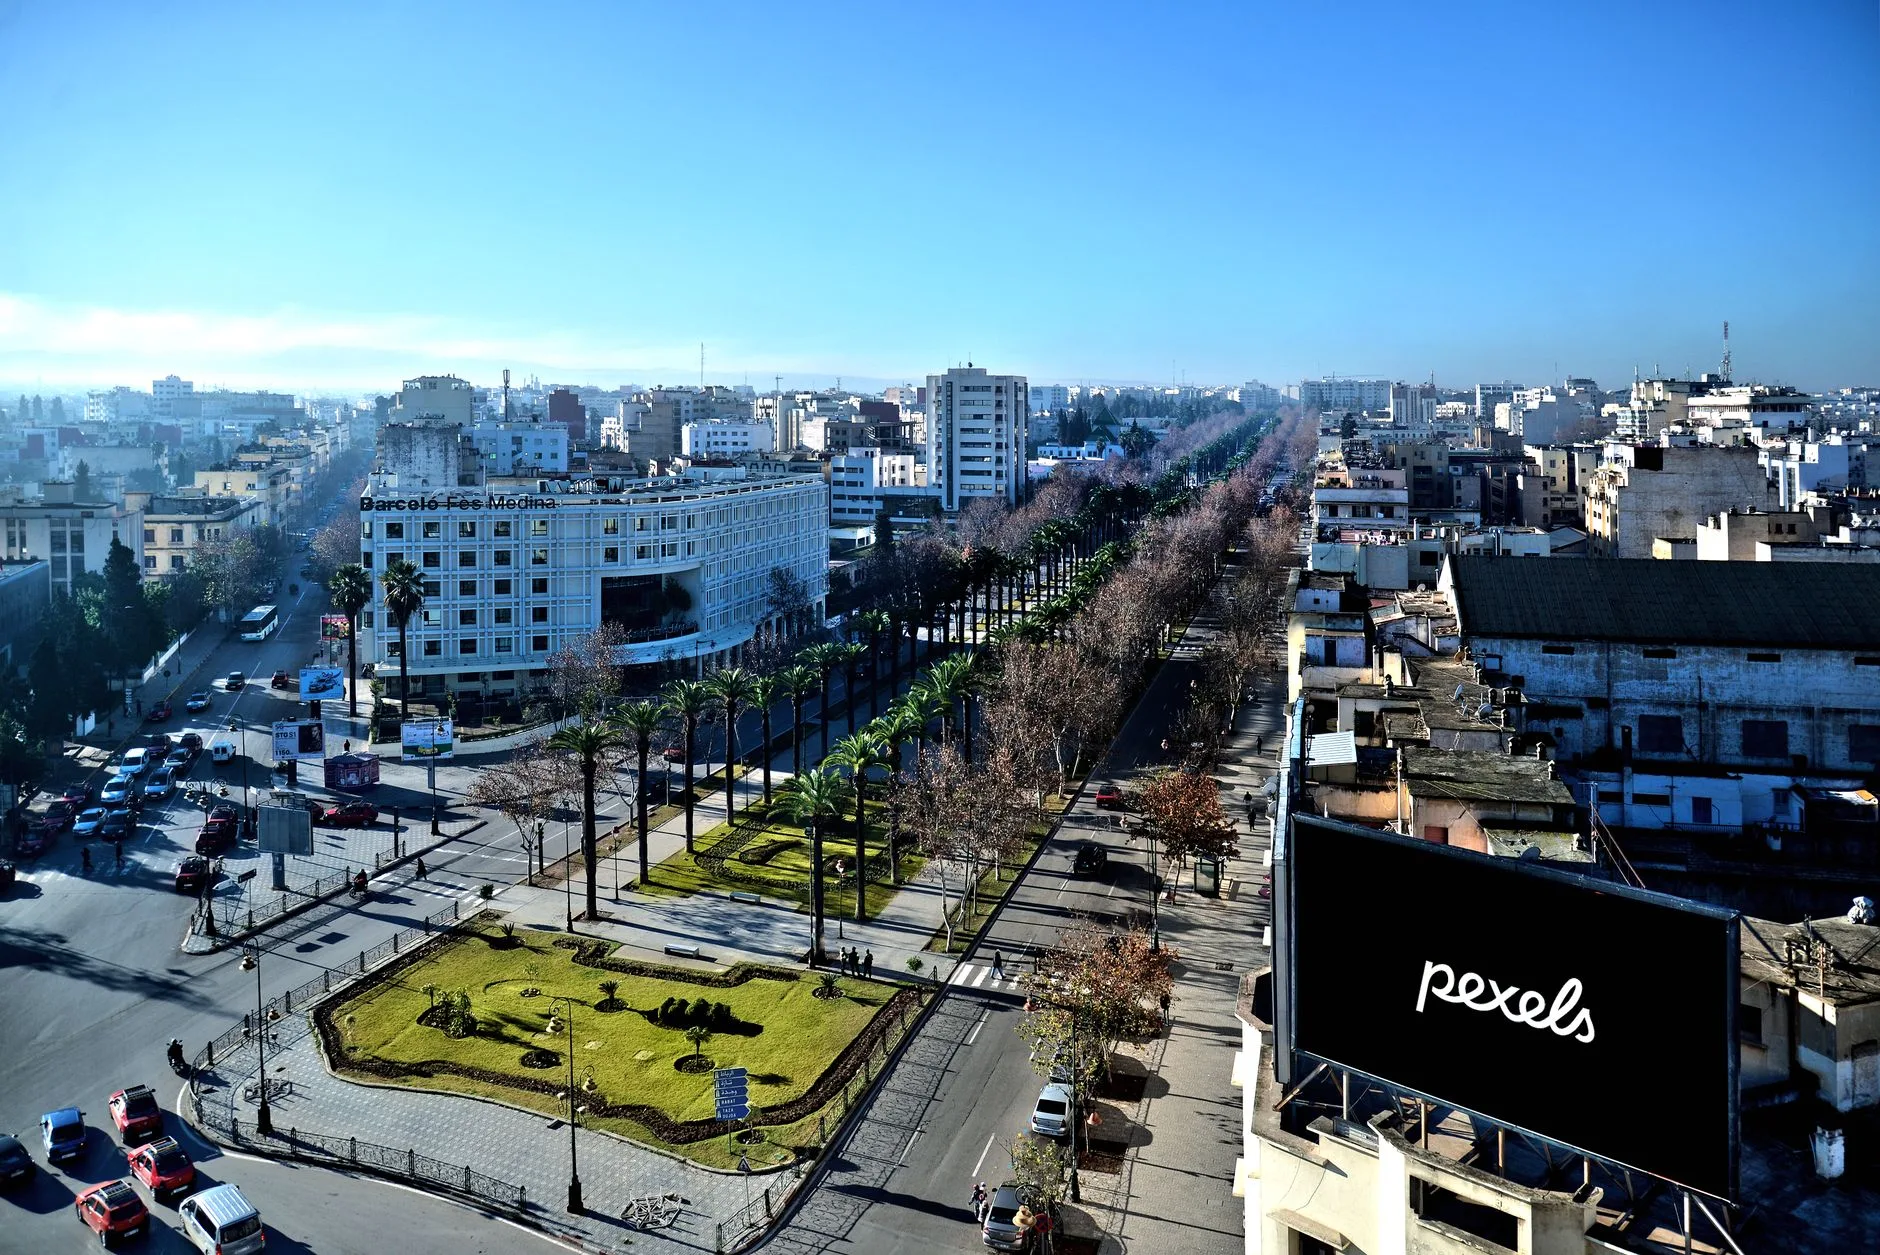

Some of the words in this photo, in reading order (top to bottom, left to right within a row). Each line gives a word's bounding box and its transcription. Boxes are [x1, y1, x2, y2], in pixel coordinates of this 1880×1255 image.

[360, 496, 438, 511] Barceló
[447, 494, 481, 510] Fès
[488, 495, 556, 510] Medina
[1415, 960, 1595, 1043] pexels
